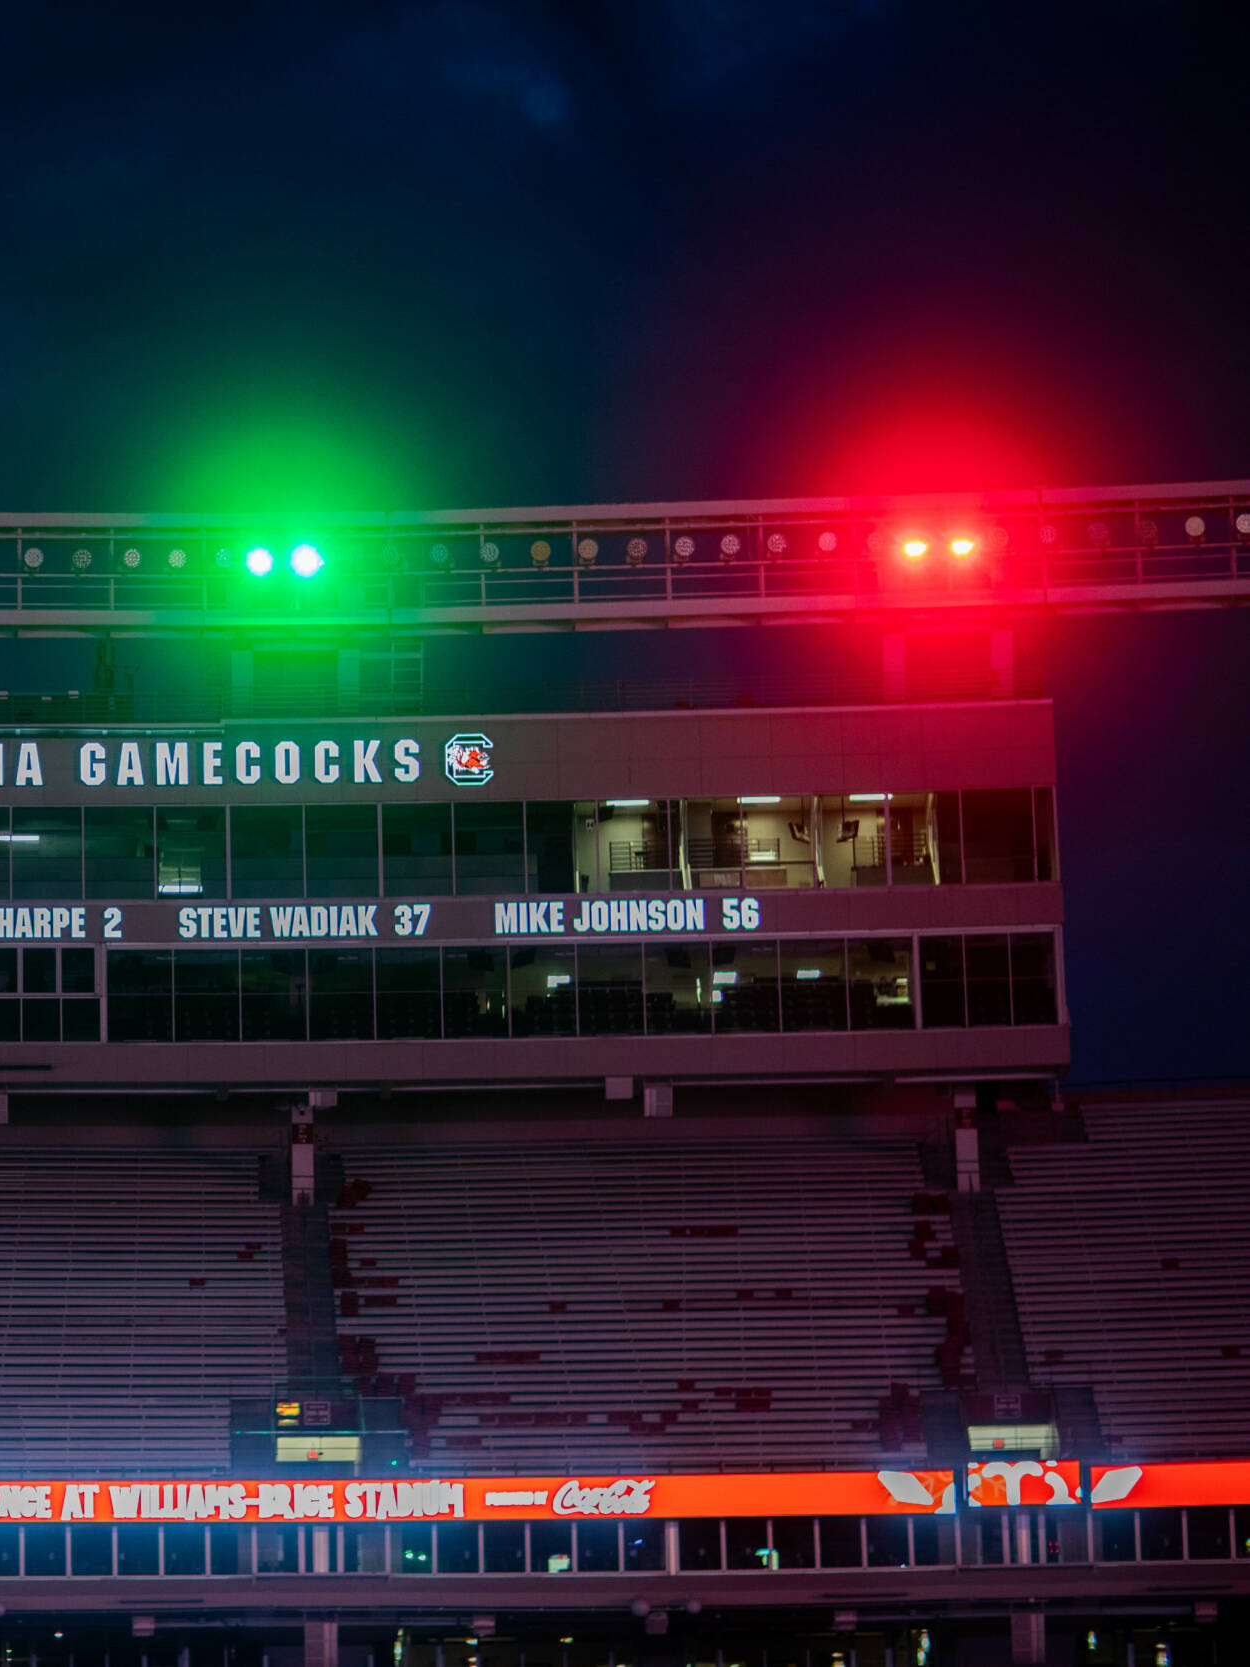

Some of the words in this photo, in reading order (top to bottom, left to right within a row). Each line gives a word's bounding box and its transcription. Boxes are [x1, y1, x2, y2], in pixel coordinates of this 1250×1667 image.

[79, 738, 421, 787] GAMECOCKS
[103, 906, 123, 939] 2
[178, 906, 262, 939] STEVE
[268, 904, 378, 938] WADIAK
[393, 903, 431, 936] 37
[494, 901, 565, 934] MIKE
[572, 899, 705, 933] JOHNSON
[721, 897, 760, 930] 56
[59, 1483, 101, 1522] AT
[107, 1482, 336, 1522] WILLIAMS-BRICE
[343, 1480, 466, 1521] STADIUM
